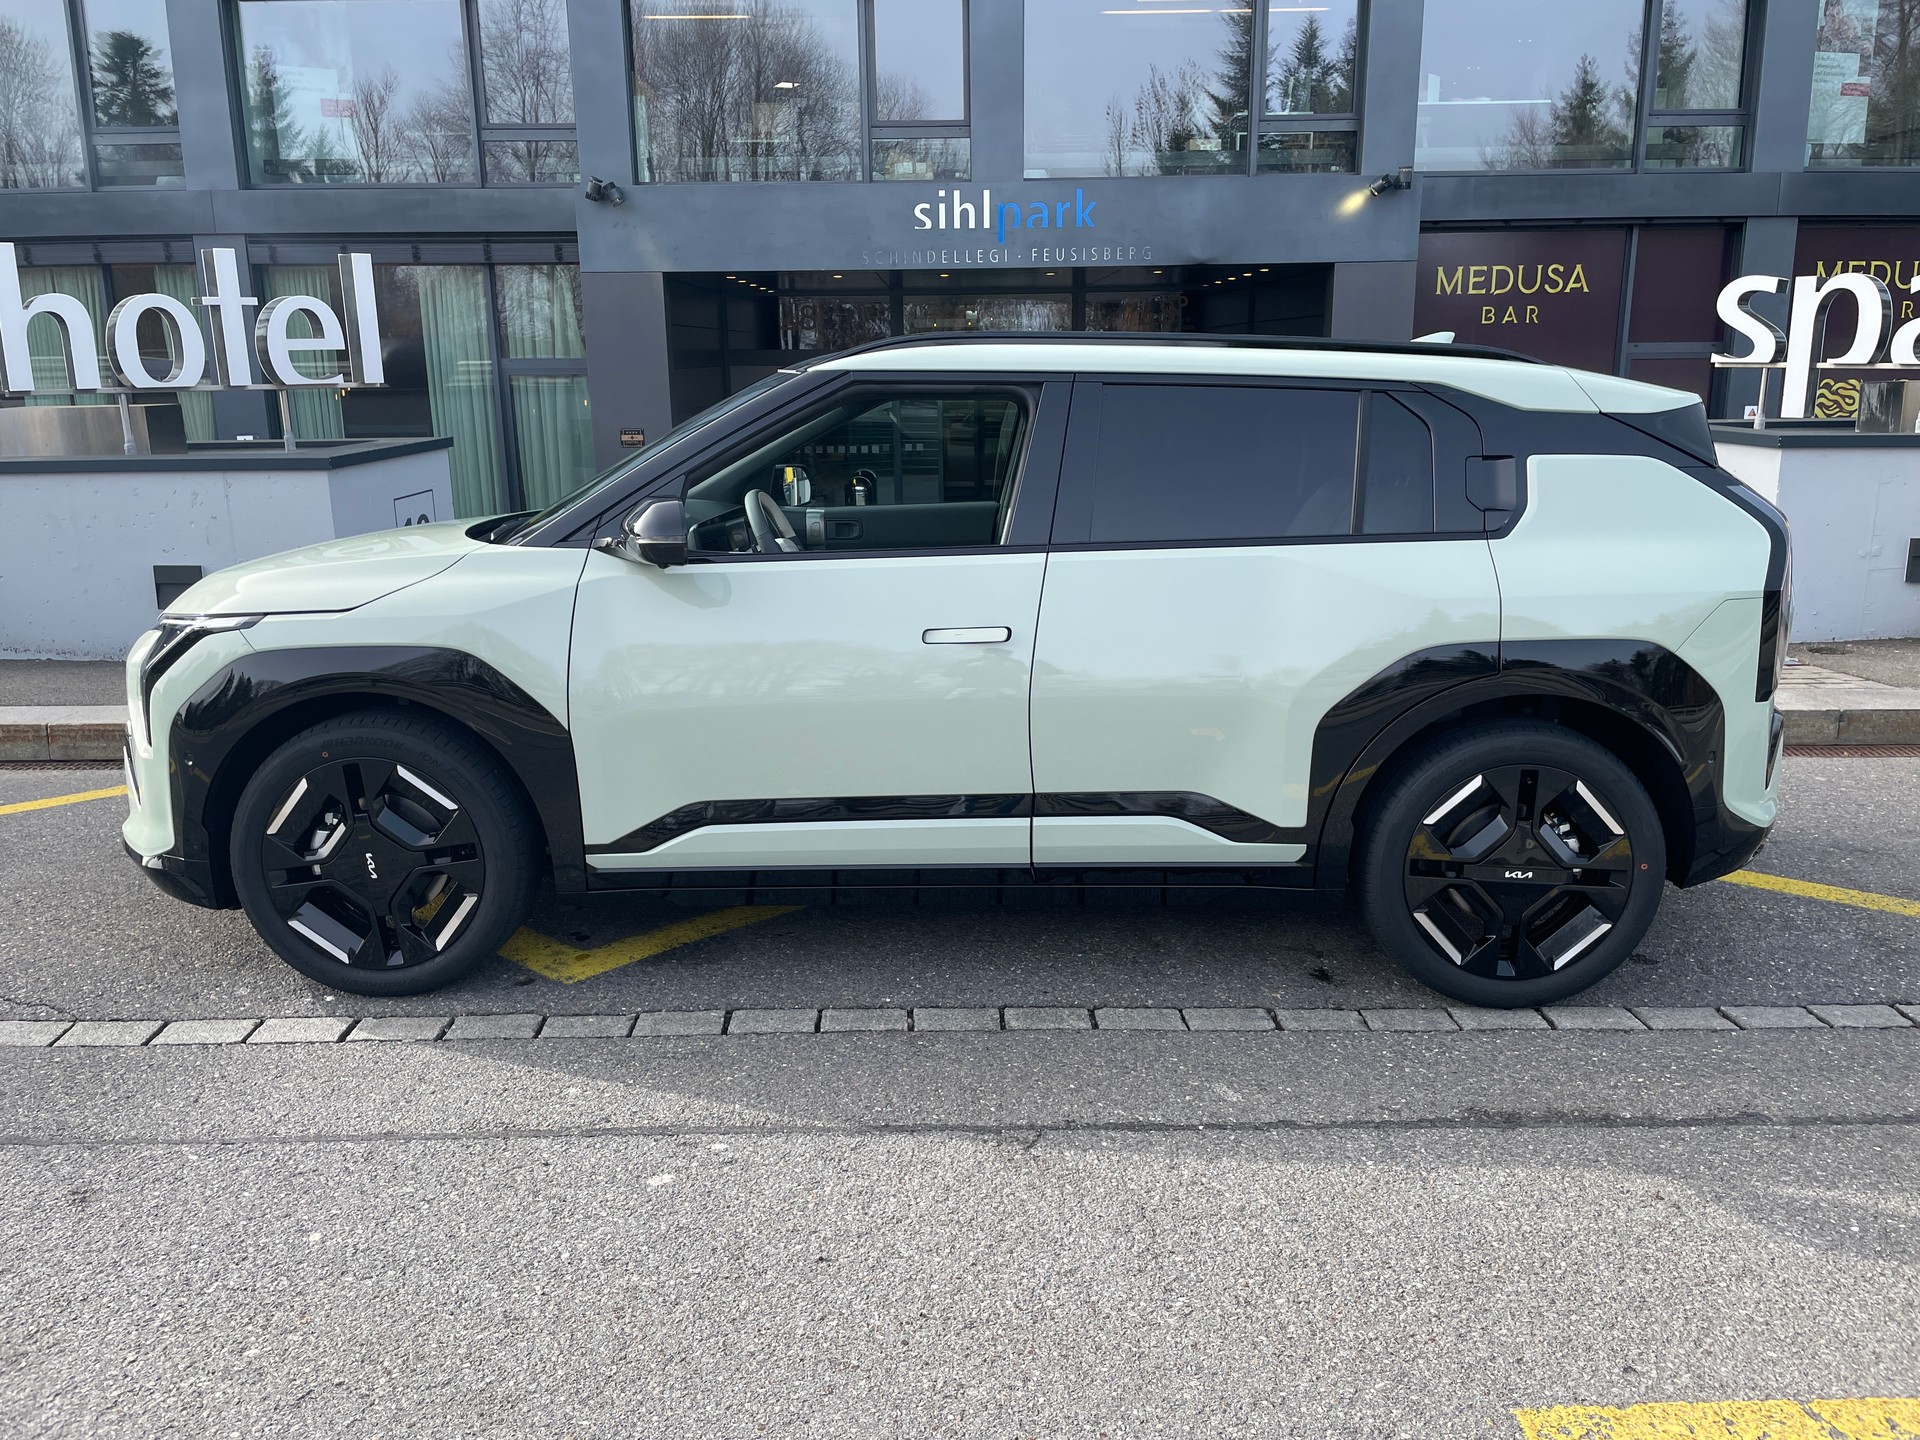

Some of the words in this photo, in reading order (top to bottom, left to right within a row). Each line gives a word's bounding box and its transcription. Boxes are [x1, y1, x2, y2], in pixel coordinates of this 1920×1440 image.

[913, 188, 1097, 244] sihlpark
[862, 248, 1008, 265] SCHINDELLEGI
[1031, 246, 1152, 262] FEUSISBERG
[1435, 263, 1589, 295] MEDUSA
[0, 242, 384, 391] hotel
[1481, 305, 1539, 324] BAR
[1504, 870, 1533, 879] KIA
